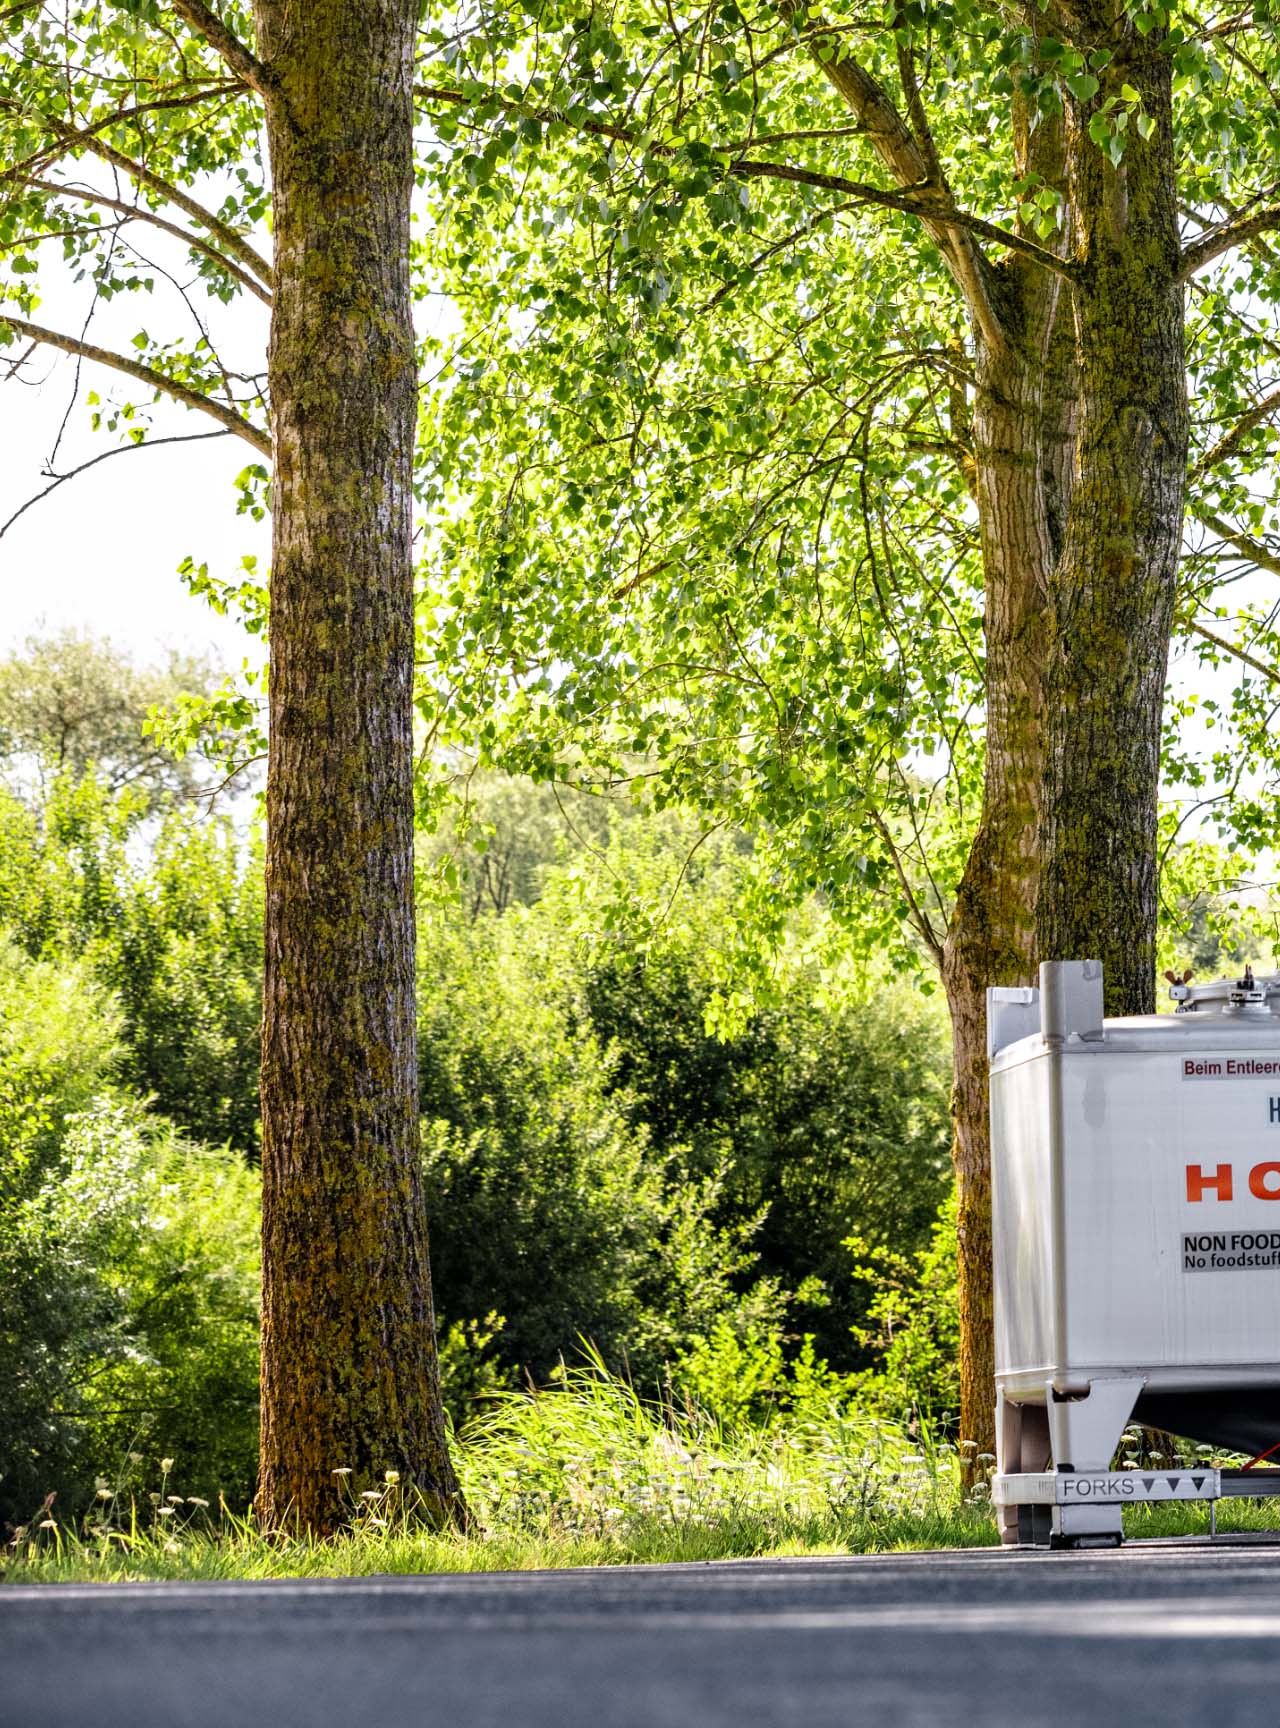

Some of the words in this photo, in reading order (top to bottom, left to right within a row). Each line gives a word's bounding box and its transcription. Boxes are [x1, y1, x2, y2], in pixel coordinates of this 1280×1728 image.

[1184, 1060, 1222, 1075] Beim
[1184, 1236, 1226, 1252] NON
[1185, 1254, 1206, 1269] No
[1063, 1478, 1135, 1496] FORKS
